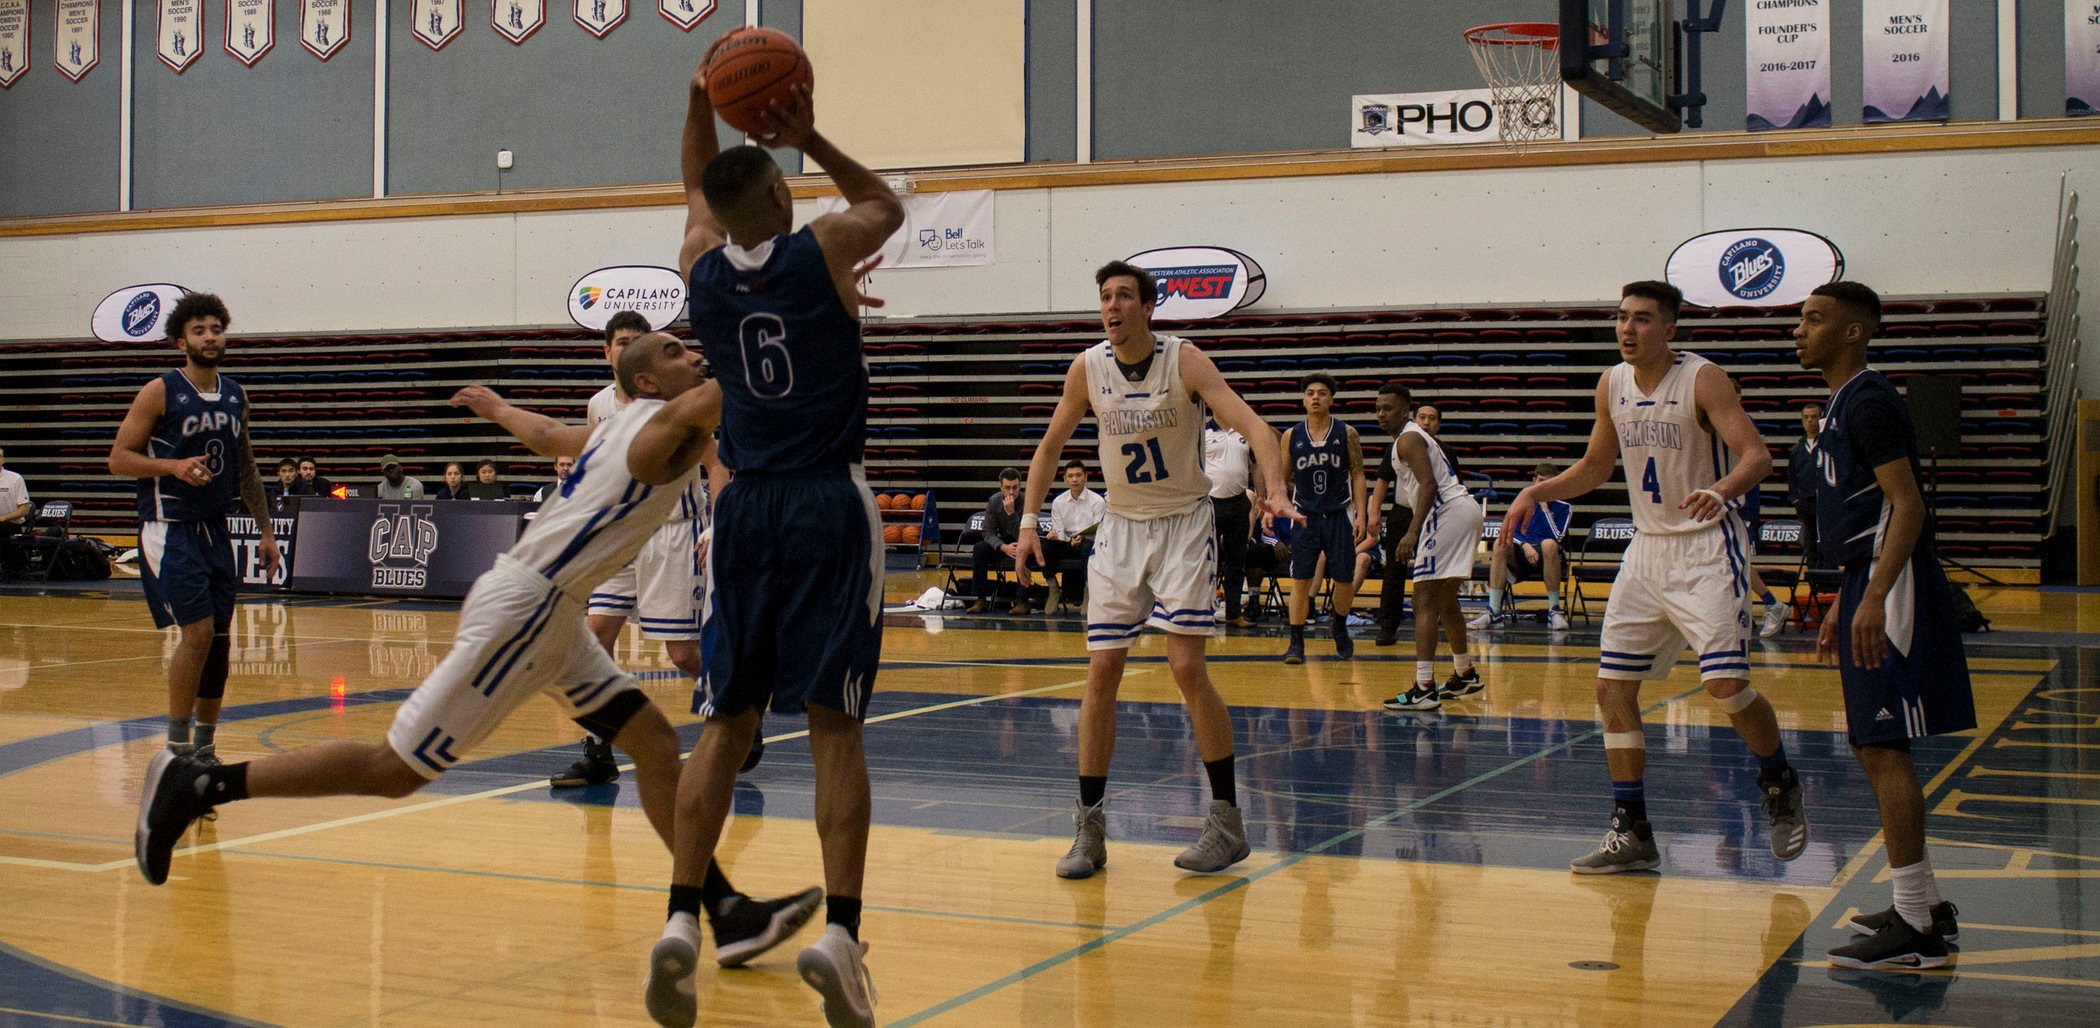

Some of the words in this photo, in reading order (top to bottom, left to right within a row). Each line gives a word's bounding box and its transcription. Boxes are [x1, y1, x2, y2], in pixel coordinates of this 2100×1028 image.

[61, 1, 94, 9] CHAMPIONS
[167, 7, 193, 15] SOCCER
[1756, 0, 1819, 10] CHAMPIONS
[1889, 15, 1923, 25] MEN'S
[1758, 23, 1818, 35] FOUNDER'S
[1884, 25, 1928, 35] SOCCER
[1777, 34, 1799, 44] CUP
[1892, 53, 1921, 63] 2016
[1760, 61, 1817, 72] 2016-2017
[945, 228, 963, 240] Bell
[946, 240, 965, 250] Let's
[966, 239, 985, 249] Talk
[1721, 240, 1758, 267] CAPILANO
[1199, 267, 1235, 275] ASSOCIATION
[1729, 247, 1774, 292] Blues
[1740, 264, 1783, 298] UNIVERSITY
[606, 288, 680, 300] CAPILANO
[604, 301, 677, 310] UNIVERSITY
[739, 312, 793, 399] 6
[182, 410, 229, 437] CAP
[1101, 408, 1178, 436] CAMOSUN
[205, 439, 224, 477] 8
[1120, 436, 1169, 484] 21
[1296, 453, 1329, 470] CAP
[1331, 453, 1341, 468] U
[1313, 470, 1327, 495] 9
[1642, 456, 1662, 504] 4
[41, 508, 67, 518] BLUES
[369, 515, 437, 565] CAP
[1594, 528, 1635, 540] BLUES
[1761, 530, 1800, 542] BLUES
[373, 568, 426, 587] BLUES
